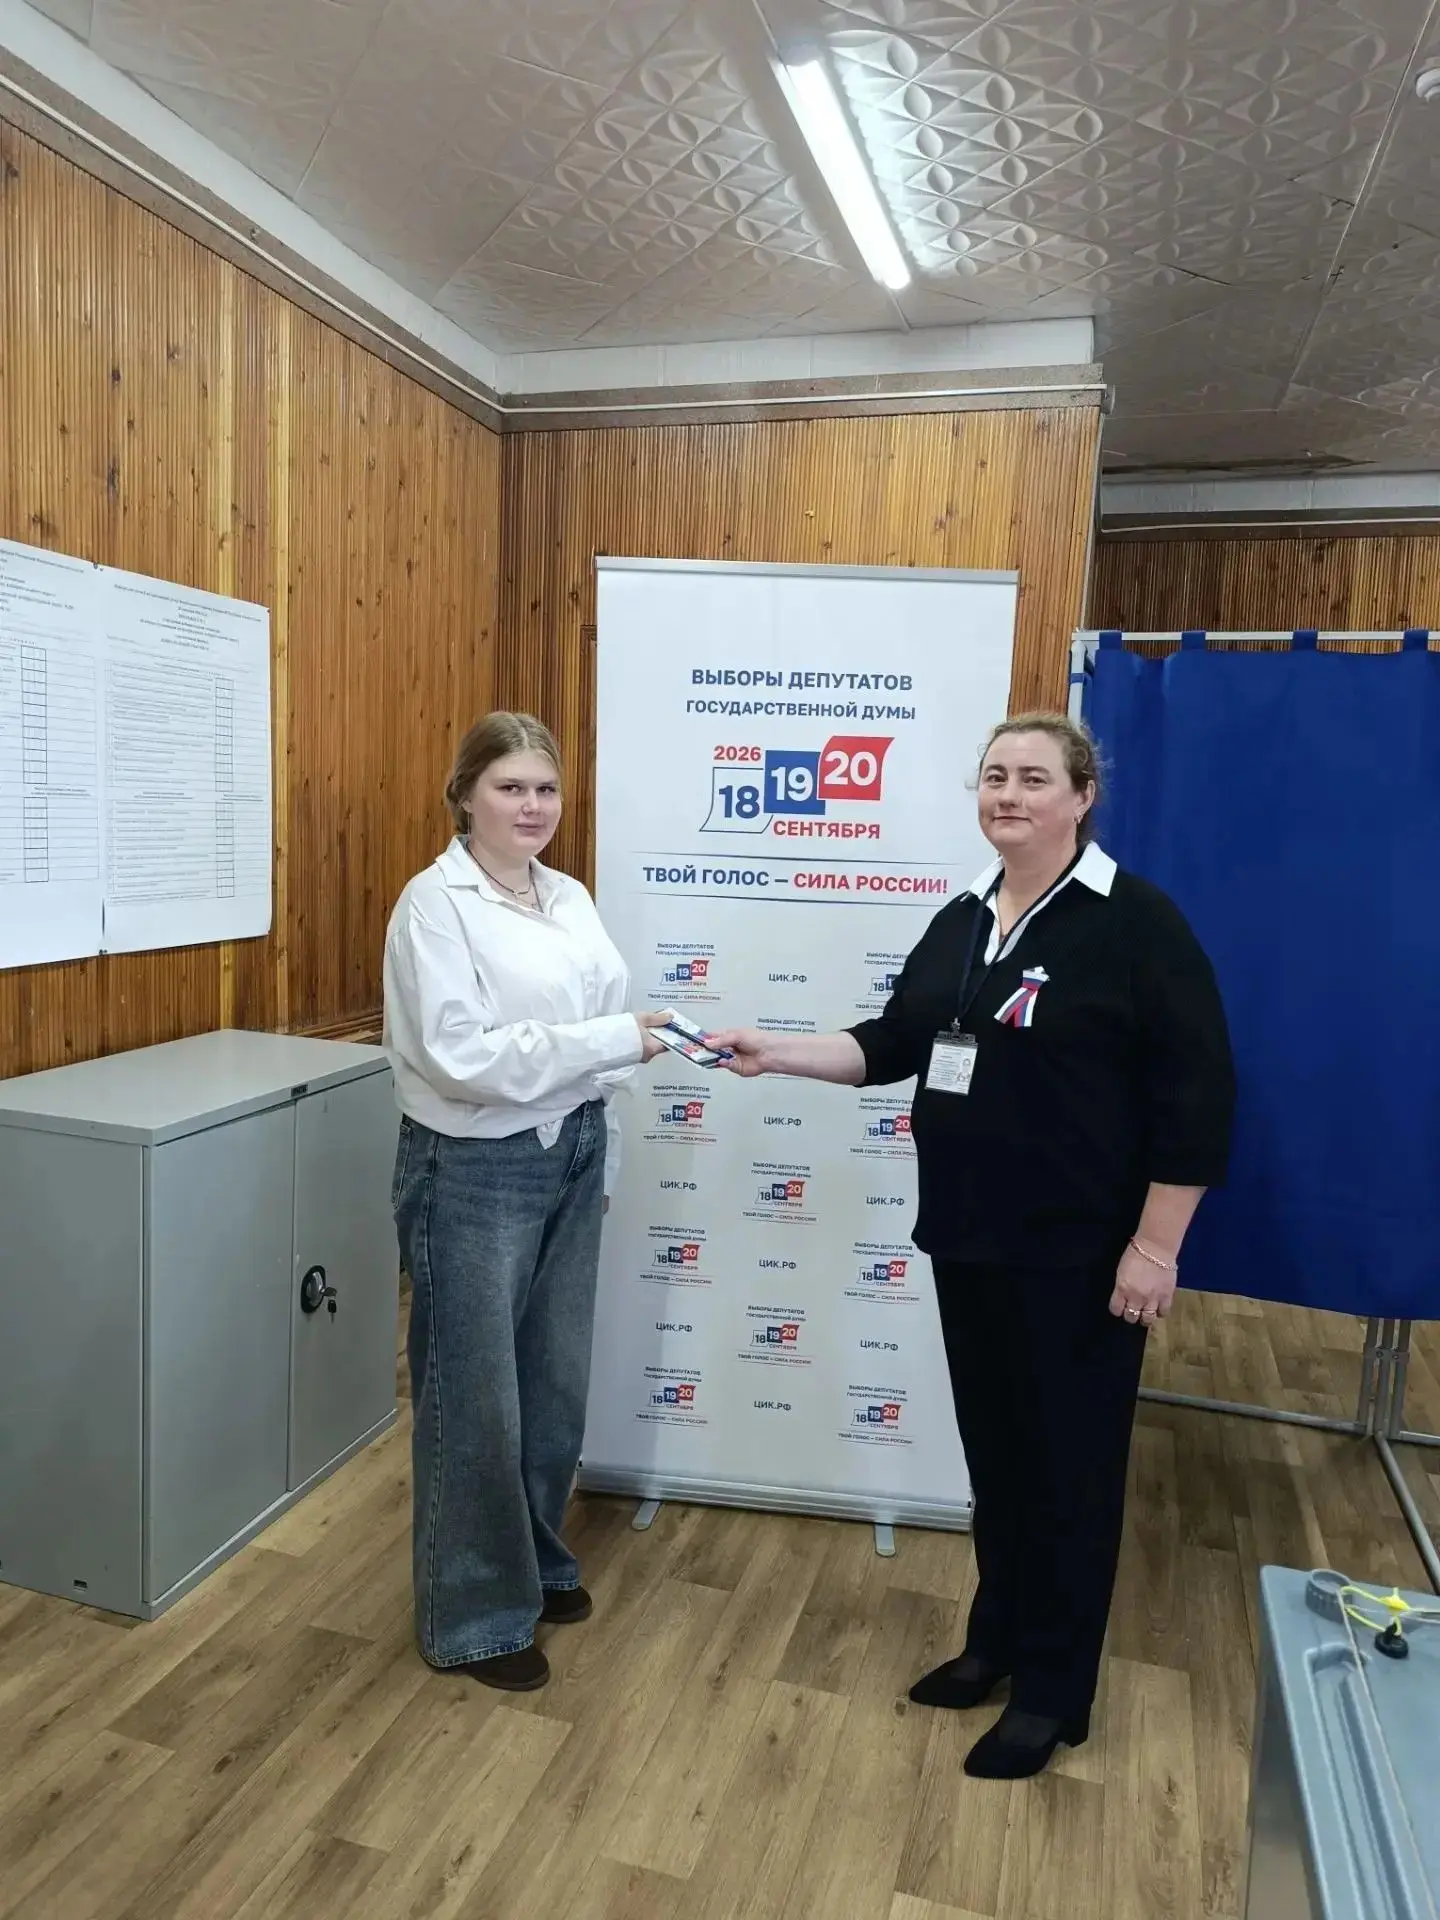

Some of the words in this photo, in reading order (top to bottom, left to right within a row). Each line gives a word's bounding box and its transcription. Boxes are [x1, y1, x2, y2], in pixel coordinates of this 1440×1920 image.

[692, 669, 783, 687] ВЫБОРЫ
[788, 672, 913, 691] ДЕПУТАТОВ
[686, 700, 857, 718] ГОСУДАРСТВЕННОЙ
[861, 705, 916, 720] ДУМЫ
[713, 746, 761, 761] 2026
[718, 785, 760, 819] 18
[771, 766, 814, 802] 19
[824, 750, 878, 786] 20
[773, 820, 880, 839] СЕНТЯБРЯ
[643, 864, 696, 884] ТВОЙ
[702, 869, 770, 887] ГОЛОС
[793, 872, 850, 890] СИЛА
[856, 875, 948, 894] РОССИИ!
[664, 973, 675, 982] 18
[678, 968, 689, 976] 19
[692, 964, 705, 972] 20
[769, 974, 807, 982] ЦИК.РФ
[873, 983, 884, 991] 18
[661, 1113, 671, 1122] 18
[674, 1109, 685, 1118] 19
[688, 1106, 700, 1114] 20
[764, 1116, 801, 1126] ЦИК.РФ
[868, 1128, 878, 1136] 18
[882, 1123, 892, 1132] 19
[896, 1119, 910, 1128] 20
[660, 1180, 697, 1190] ЦИК.РФ
[760, 1192, 770, 1200] 18
[774, 1188, 784, 1197] 19
[787, 1184, 800, 1193] 20
[866, 1197, 904, 1205] ЦИК.РФ
[657, 1255, 667, 1263] 18
[670, 1251, 680, 1260] 19
[683, 1248, 696, 1257] 20
[759, 1259, 796, 1269] ЦИК.РФ
[862, 1272, 872, 1280] 18
[875, 1268, 886, 1277] 19
[890, 1265, 904, 1273] 20
[656, 1322, 692, 1332] ЦИК.РФ
[755, 1335, 765, 1343] 18
[768, 1331, 779, 1339] 19
[782, 1328, 795, 1337] 20
[860, 1340, 898, 1351] ЦИК.РФ
[652, 1395, 662, 1403] 18
[666, 1391, 676, 1400] 19
[679, 1388, 692, 1397] 20
[754, 1400, 791, 1411] ЦИК.РФ
[856, 1414, 866, 1422] 18
[869, 1411, 880, 1419] 19
[884, 1408, 897, 1416] 20
